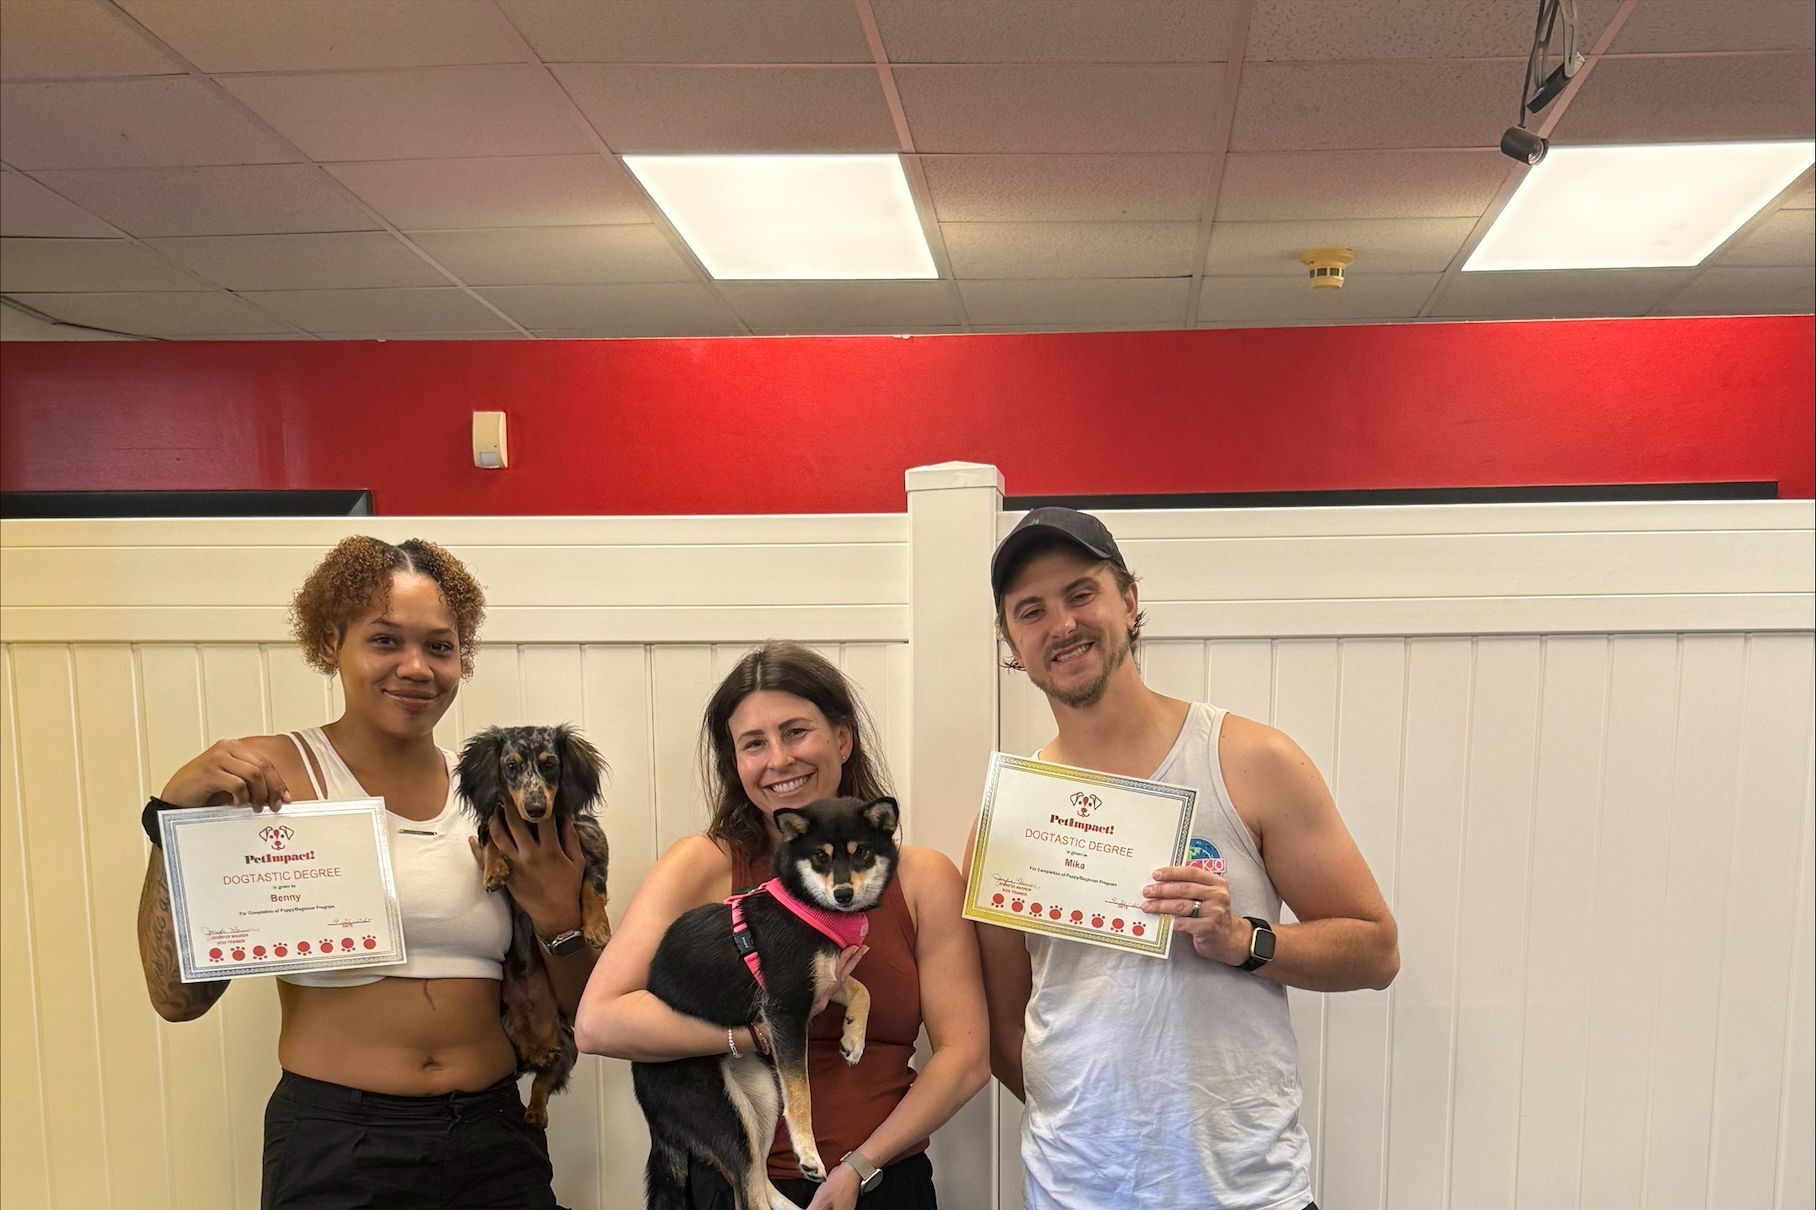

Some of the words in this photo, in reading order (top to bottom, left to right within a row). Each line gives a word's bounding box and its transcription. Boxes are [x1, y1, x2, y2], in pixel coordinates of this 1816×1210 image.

[1049, 814, 1115, 835] PetImpact!
[1025, 828, 1086, 849] DOGTASTIC
[1088, 840, 1134, 858] DEGREE
[244, 850, 316, 864] PetImpact!
[1064, 858, 1086, 870] Mika
[223, 871, 291, 885] DOGTASTIC
[294, 867, 342, 880] DEGREE
[270, 893, 301, 903] Benny
